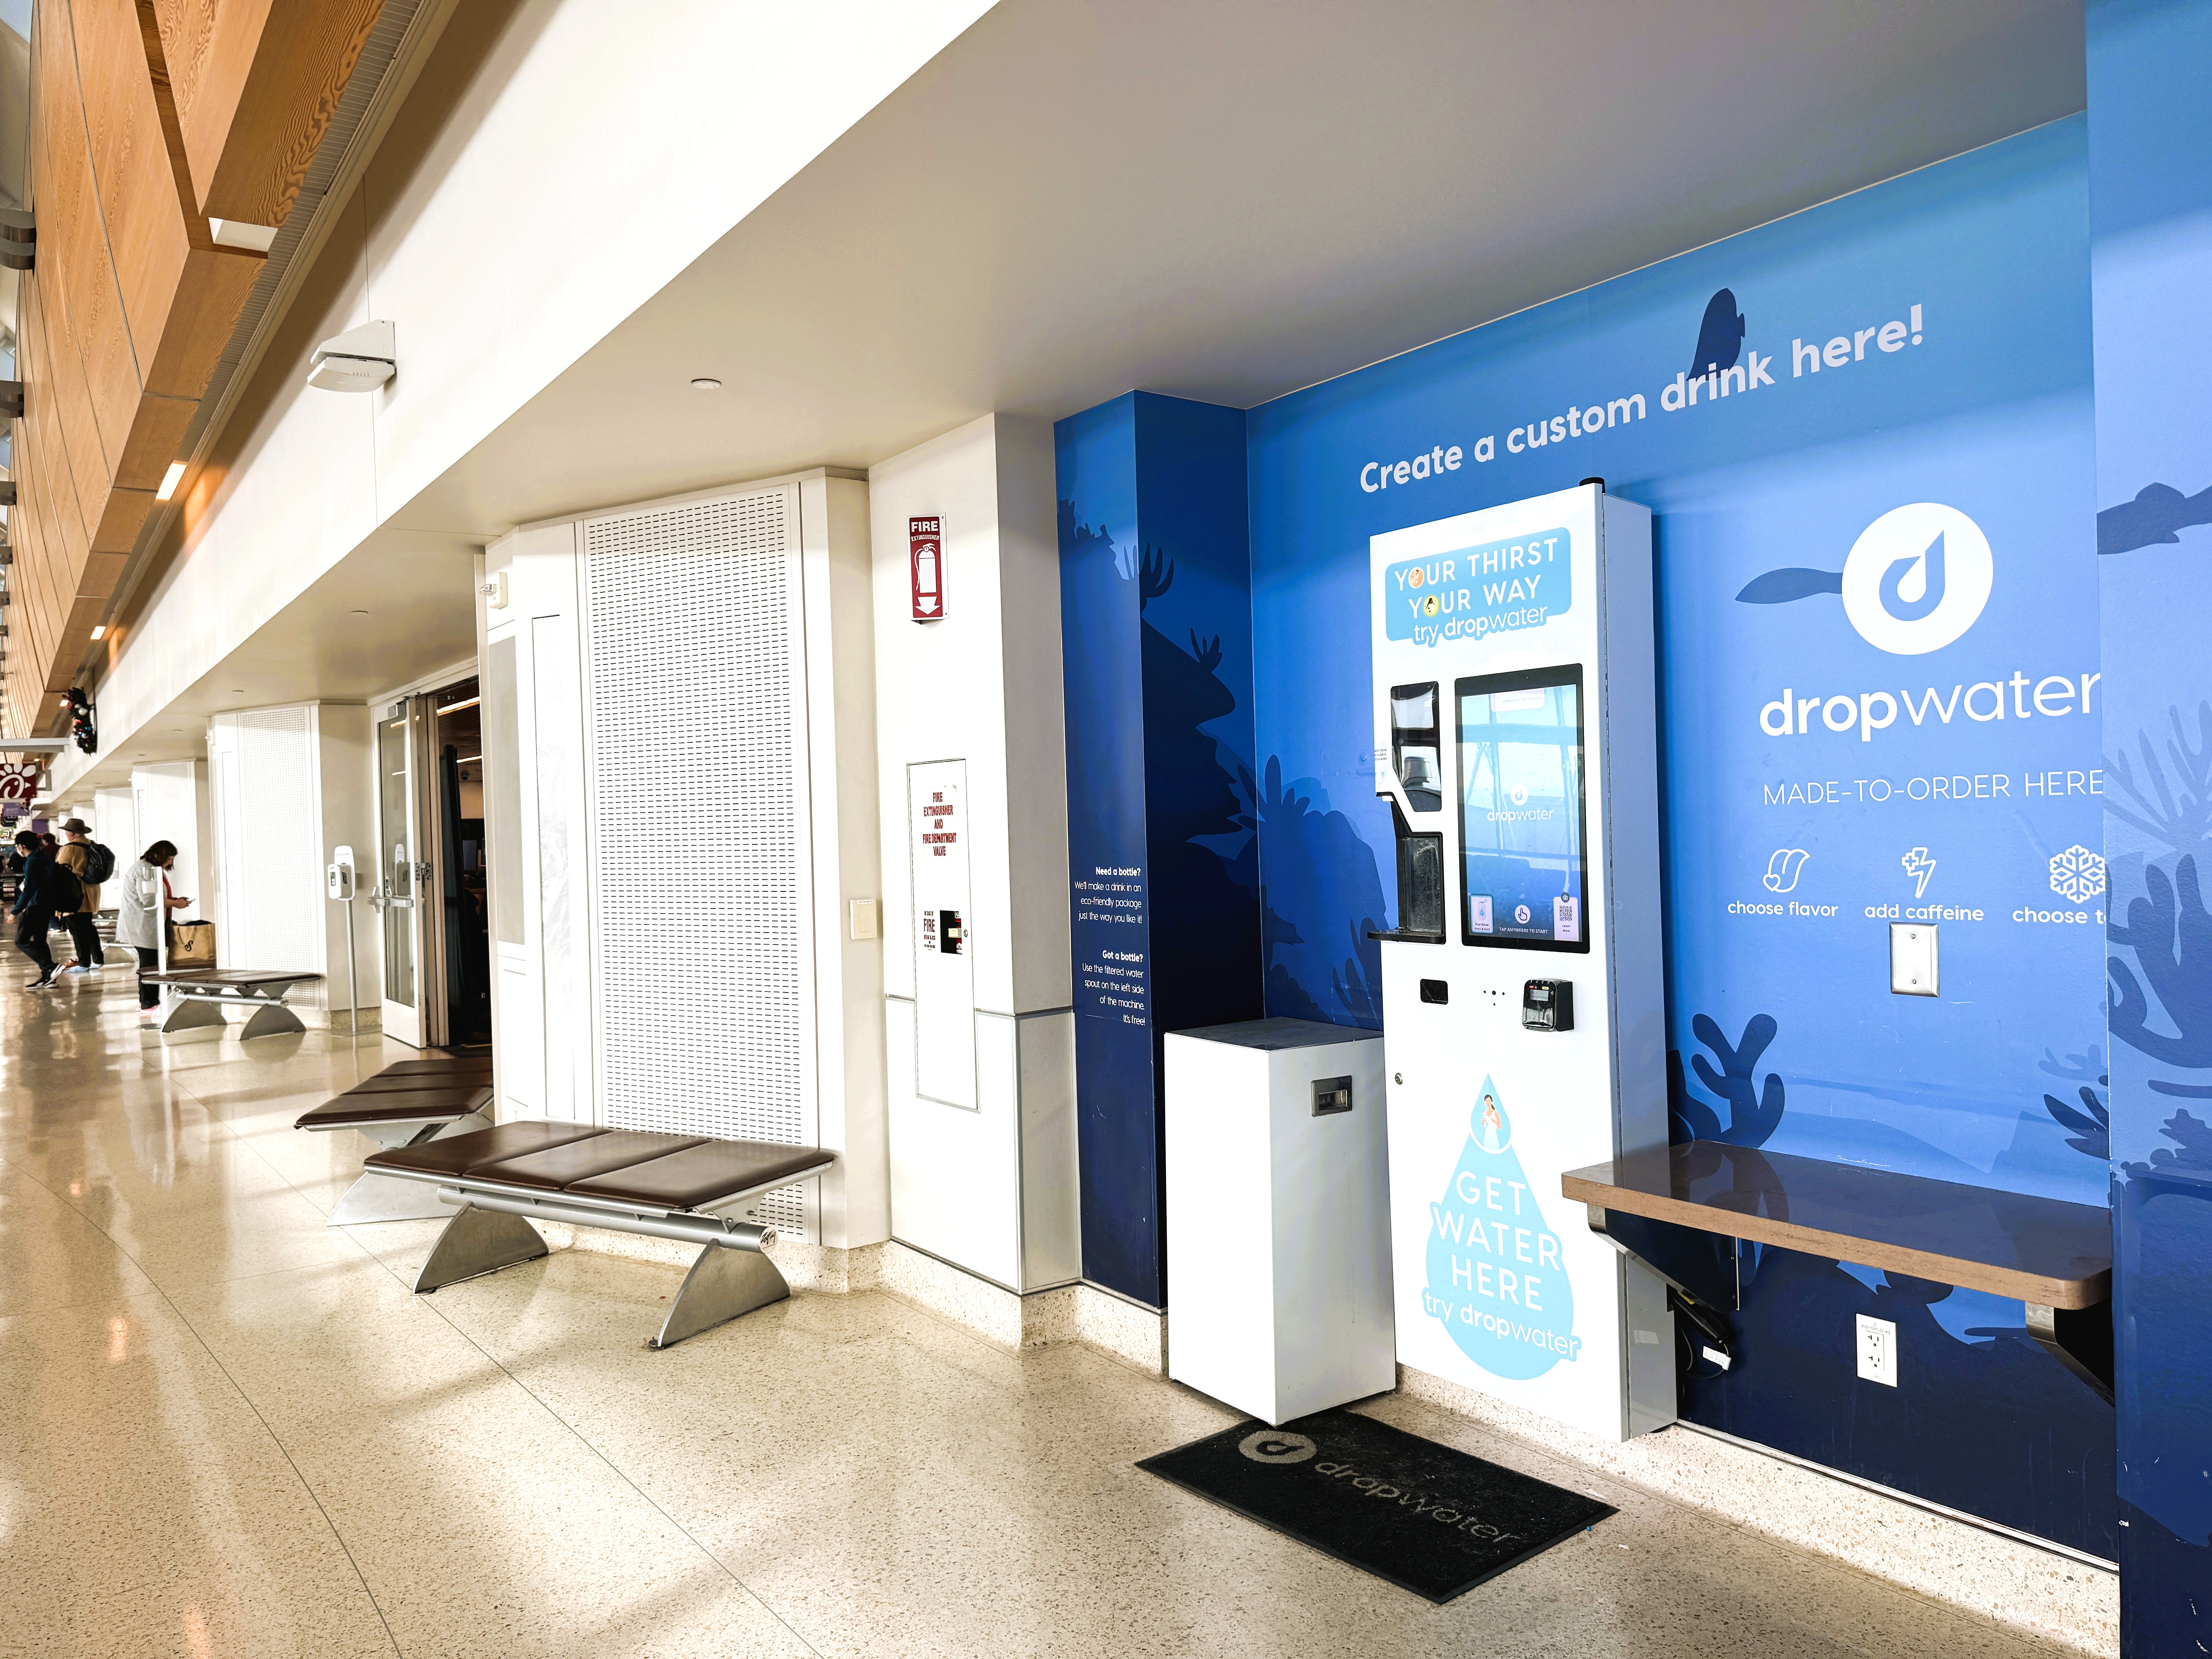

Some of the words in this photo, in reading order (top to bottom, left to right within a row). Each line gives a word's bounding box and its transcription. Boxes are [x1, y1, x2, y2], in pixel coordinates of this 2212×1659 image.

[1360, 446, 1463, 493] Create
[1474, 435, 1494, 462] a
[1507, 394, 1646, 453] custom
[1661, 351, 1776, 411] drink
[1792, 304, 1922, 378] here!
[911, 521, 938, 532] FIRE
[1395, 560, 1455, 591] YOUR
[1467, 538, 1558, 576] THIRST
[1408, 589, 1471, 618] YOUR
[1483, 575, 1541, 606] WAY
[1414, 624, 1439, 644] try
[1444, 606, 1547, 636] dropwater
[1760, 671, 2100, 742] dropwater
[1764, 774, 2011, 805] MADE-TO-ORDER
[2025, 769, 2103, 796] HERE
[933, 792, 943, 802] FIRE
[924, 805, 953, 816] EXTINGUISHER
[1487, 808, 1554, 824] dropwater
[934, 819, 943, 829] AND
[923, 834, 931, 844] FIRE
[932, 833, 957, 843] DEPARTMENT
[933, 846, 946, 856] VALVE
[1096, 867, 1111, 875] Need
[1119, 867, 1141, 876] bottle?
[1075, 881, 1086, 890] We'll
[1088, 882, 1104, 890] make
[1111, 883, 1125, 891] drink
[1127, 883, 1132, 891] in
[1080, 896, 1114, 908] eco-friendly
[1115, 899, 1142, 910] package
[1728, 900, 1783, 915] choose
[1788, 901, 1839, 917] flavor
[1079, 911, 1088, 921] just
[1089, 912, 1098, 920] the
[1100, 915, 1113, 923] way
[1114, 915, 1125, 923] you
[1126, 914, 1135, 923] like
[1864, 903, 1899, 918] add
[1905, 904, 1984, 921] caffeine
[2012, 907, 2088, 924] choose
[2095, 909, 2106, 924] t
[924, 918, 935, 932] FIRE
[1103, 950, 1113, 959] Got
[1121, 951, 1143, 962] bottle?
[1082, 963, 1092, 972] Use
[1094, 964, 1103, 973] the
[1104, 965, 1124, 976] filtered
[1125, 969, 1144, 978] water
[1085, 980, 1100, 988] spout
[1110, 982, 1120, 991] the
[1121, 982, 1130, 993] left
[1132, 984, 1144, 994] side
[1100, 995, 1106, 1004] of
[1108, 996, 1117, 1006] the
[1118, 1000, 1145, 1010] machine.
[1132, 1015, 1146, 1026] free!
[1456, 1171, 1526, 1216] GET
[1433, 1206, 1560, 1271] WATER
[1451, 1254, 1543, 1311] HERE
[1424, 1291, 1451, 1322] try
[1460, 1302, 1578, 1358] dropwater
[1316, 1461, 1521, 1544] dropwater
